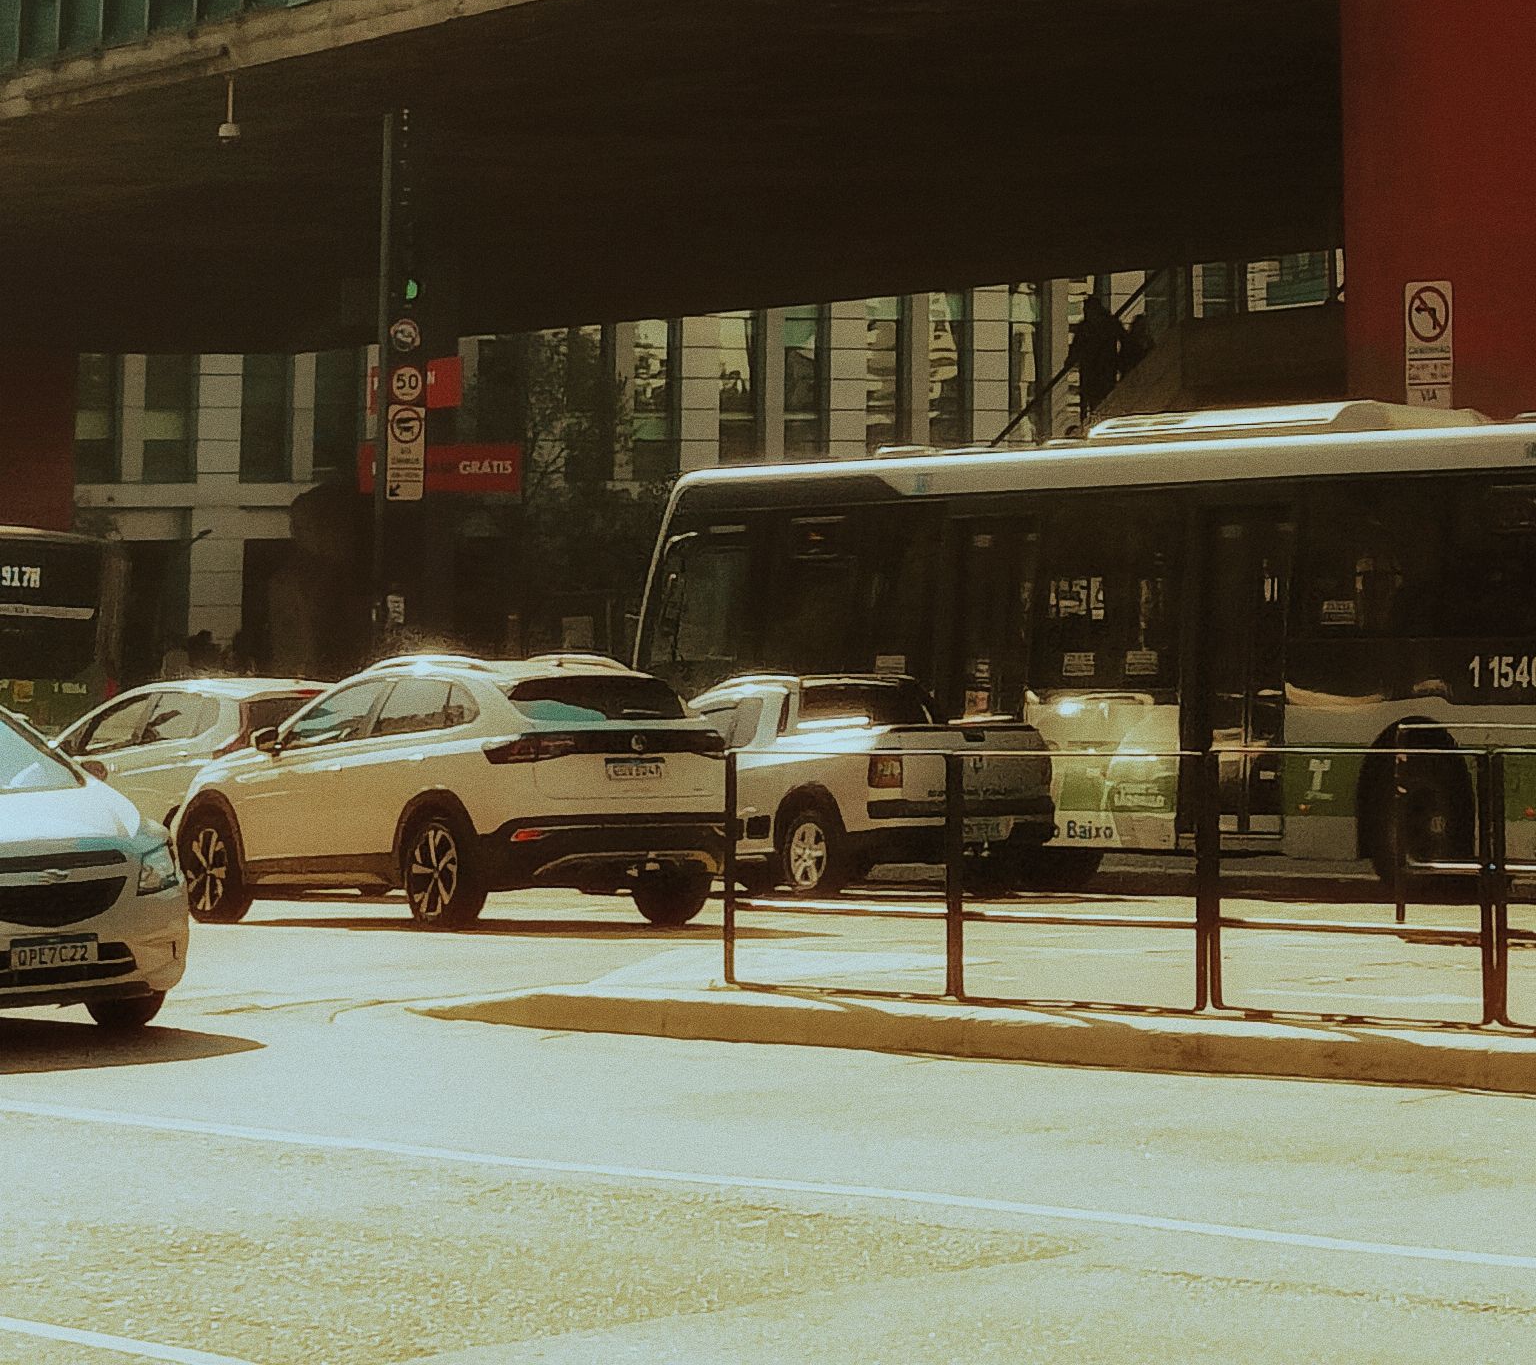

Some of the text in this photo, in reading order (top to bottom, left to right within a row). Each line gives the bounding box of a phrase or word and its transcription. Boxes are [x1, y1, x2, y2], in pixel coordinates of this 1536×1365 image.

[396, 373, 420, 390] 50
[459, 457, 513, 475] GRÁTIS
[1066, 820, 1114, 840] Baixo
